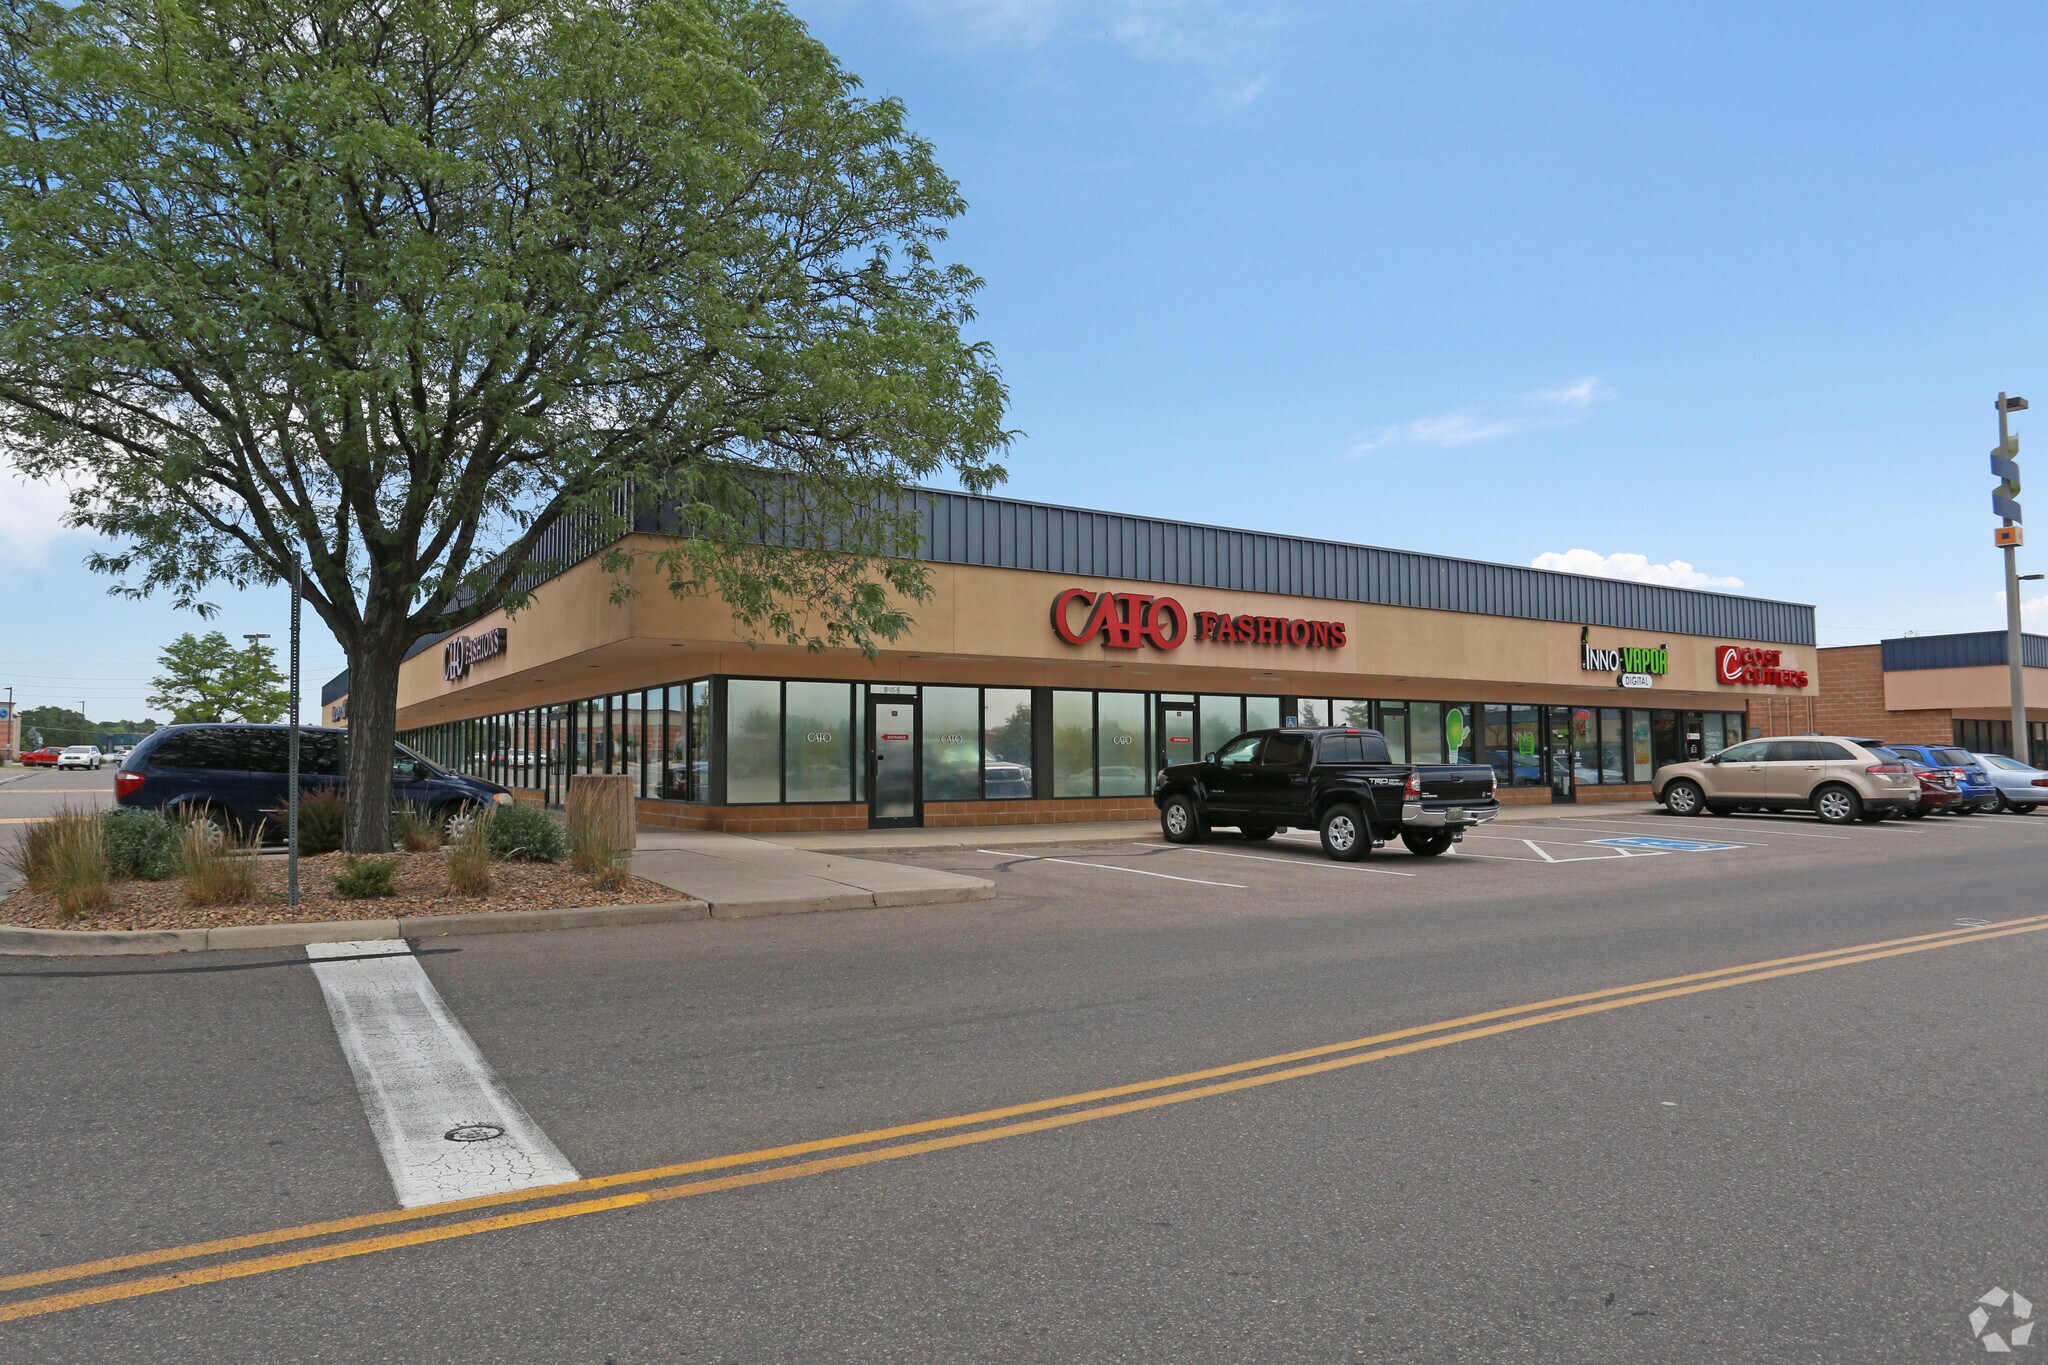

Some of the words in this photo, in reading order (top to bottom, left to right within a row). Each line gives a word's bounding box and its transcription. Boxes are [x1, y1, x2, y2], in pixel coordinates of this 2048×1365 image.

[1050, 588, 1188, 650] CATO
[1194, 610, 1347, 649] FASHIONS
[444, 636, 467, 681] CATO
[465, 628, 503, 664] FASHIONS
[1742, 647, 1782, 667] COST
[1625, 675, 1649, 686] DIGITAL
[1742, 667, 1808, 688] CUTTERS
[806, 731, 832, 744] CATO
[940, 733, 963, 745] CATO
